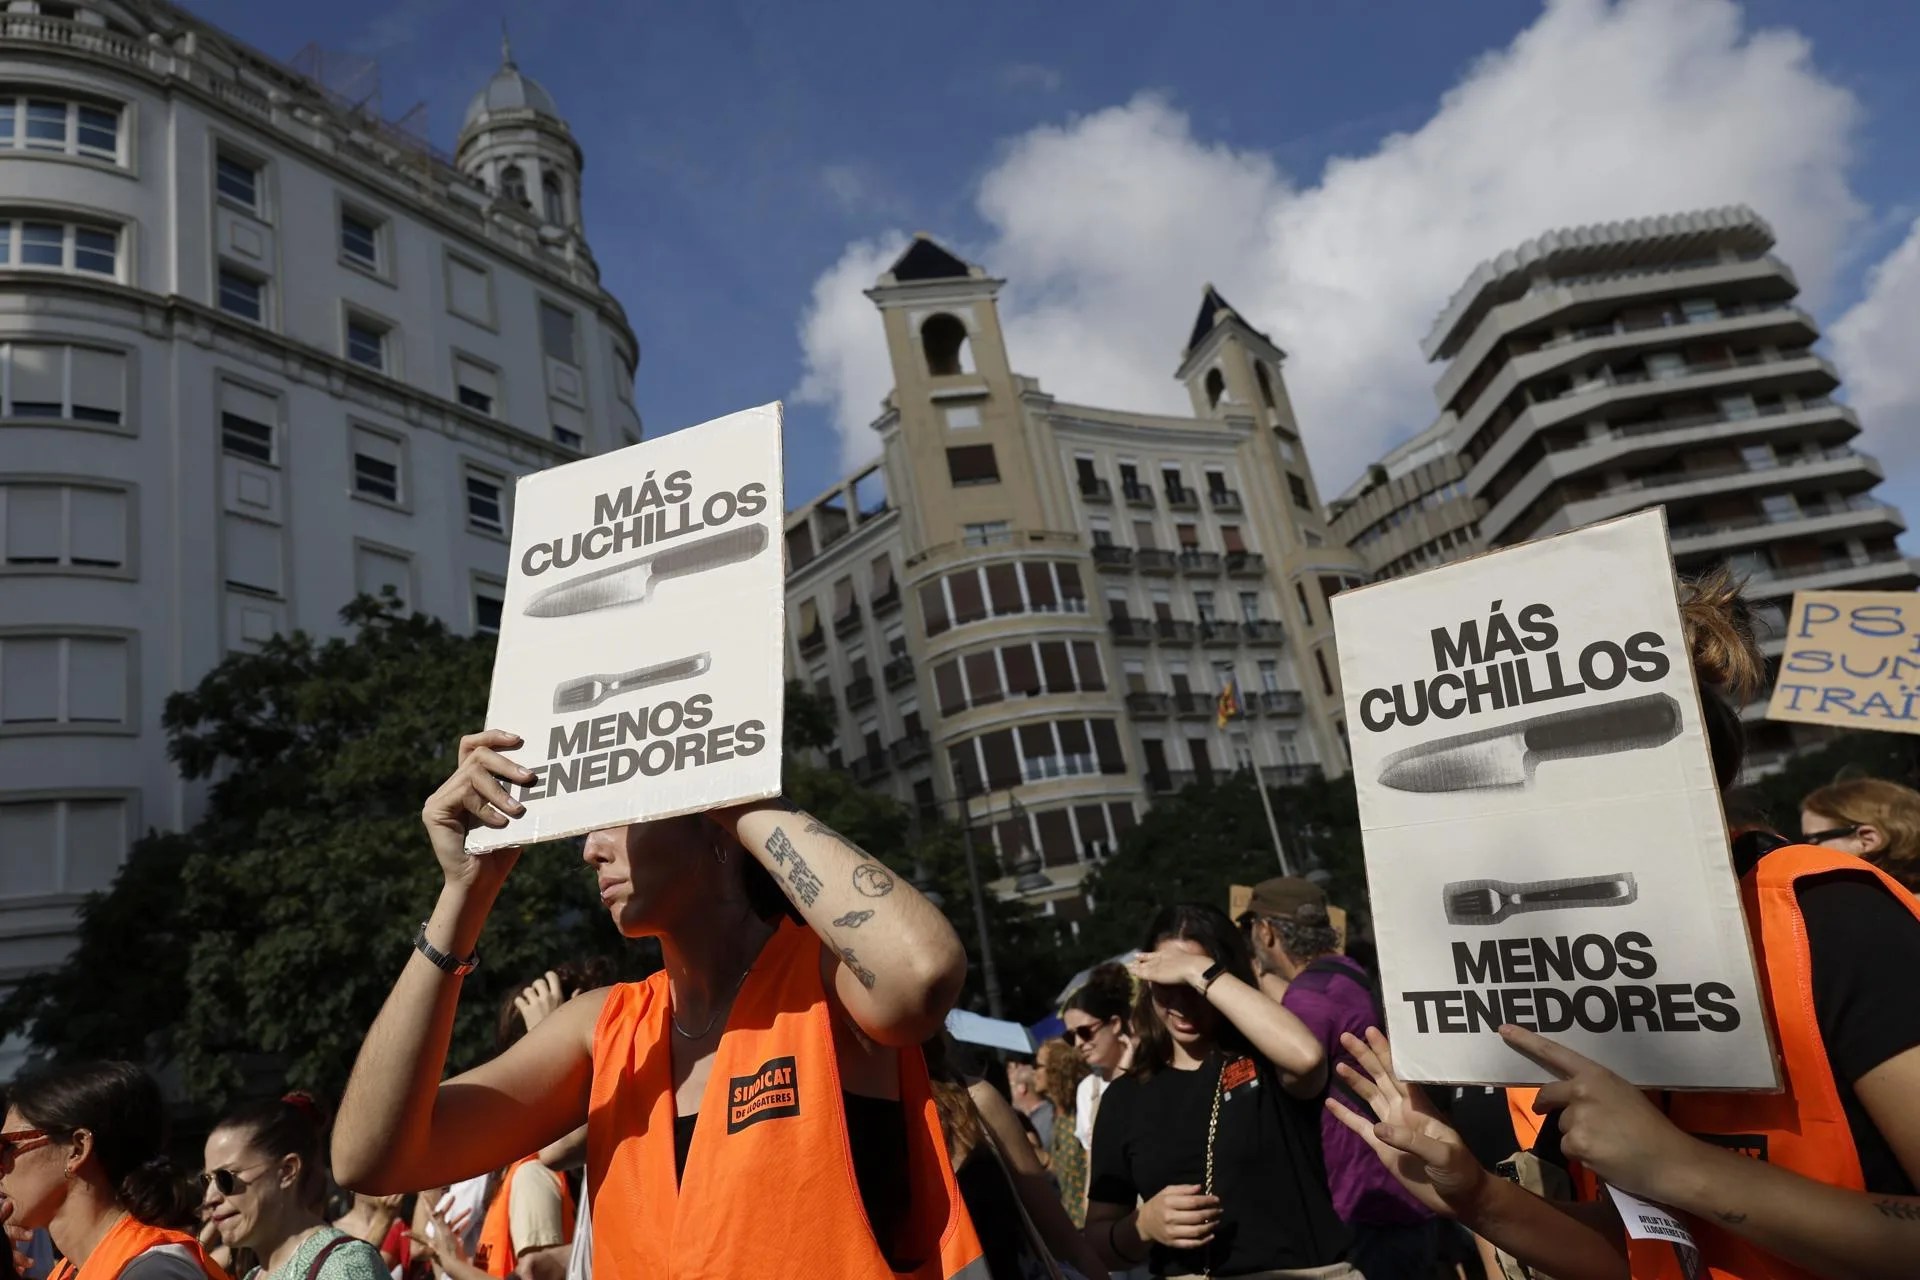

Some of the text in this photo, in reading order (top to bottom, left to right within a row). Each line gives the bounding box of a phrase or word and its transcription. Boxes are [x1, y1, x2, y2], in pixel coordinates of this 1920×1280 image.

[593, 470, 693, 526] MÁS
[521, 482, 767, 576] CUCHILLOS
[1430, 599, 1559, 672] MÁS
[1359, 631, 1670, 733] CUCHILLOS
[547, 693, 713, 760] MENOS
[503, 719, 766, 803] ENEDORES
[1451, 931, 1657, 984] MENOS
[1402, 982, 1741, 1033] TENEDORES
[733, 1067, 791, 1103] SINDICAT
[735, 1093, 792, 1119] DE LLOGATERES
